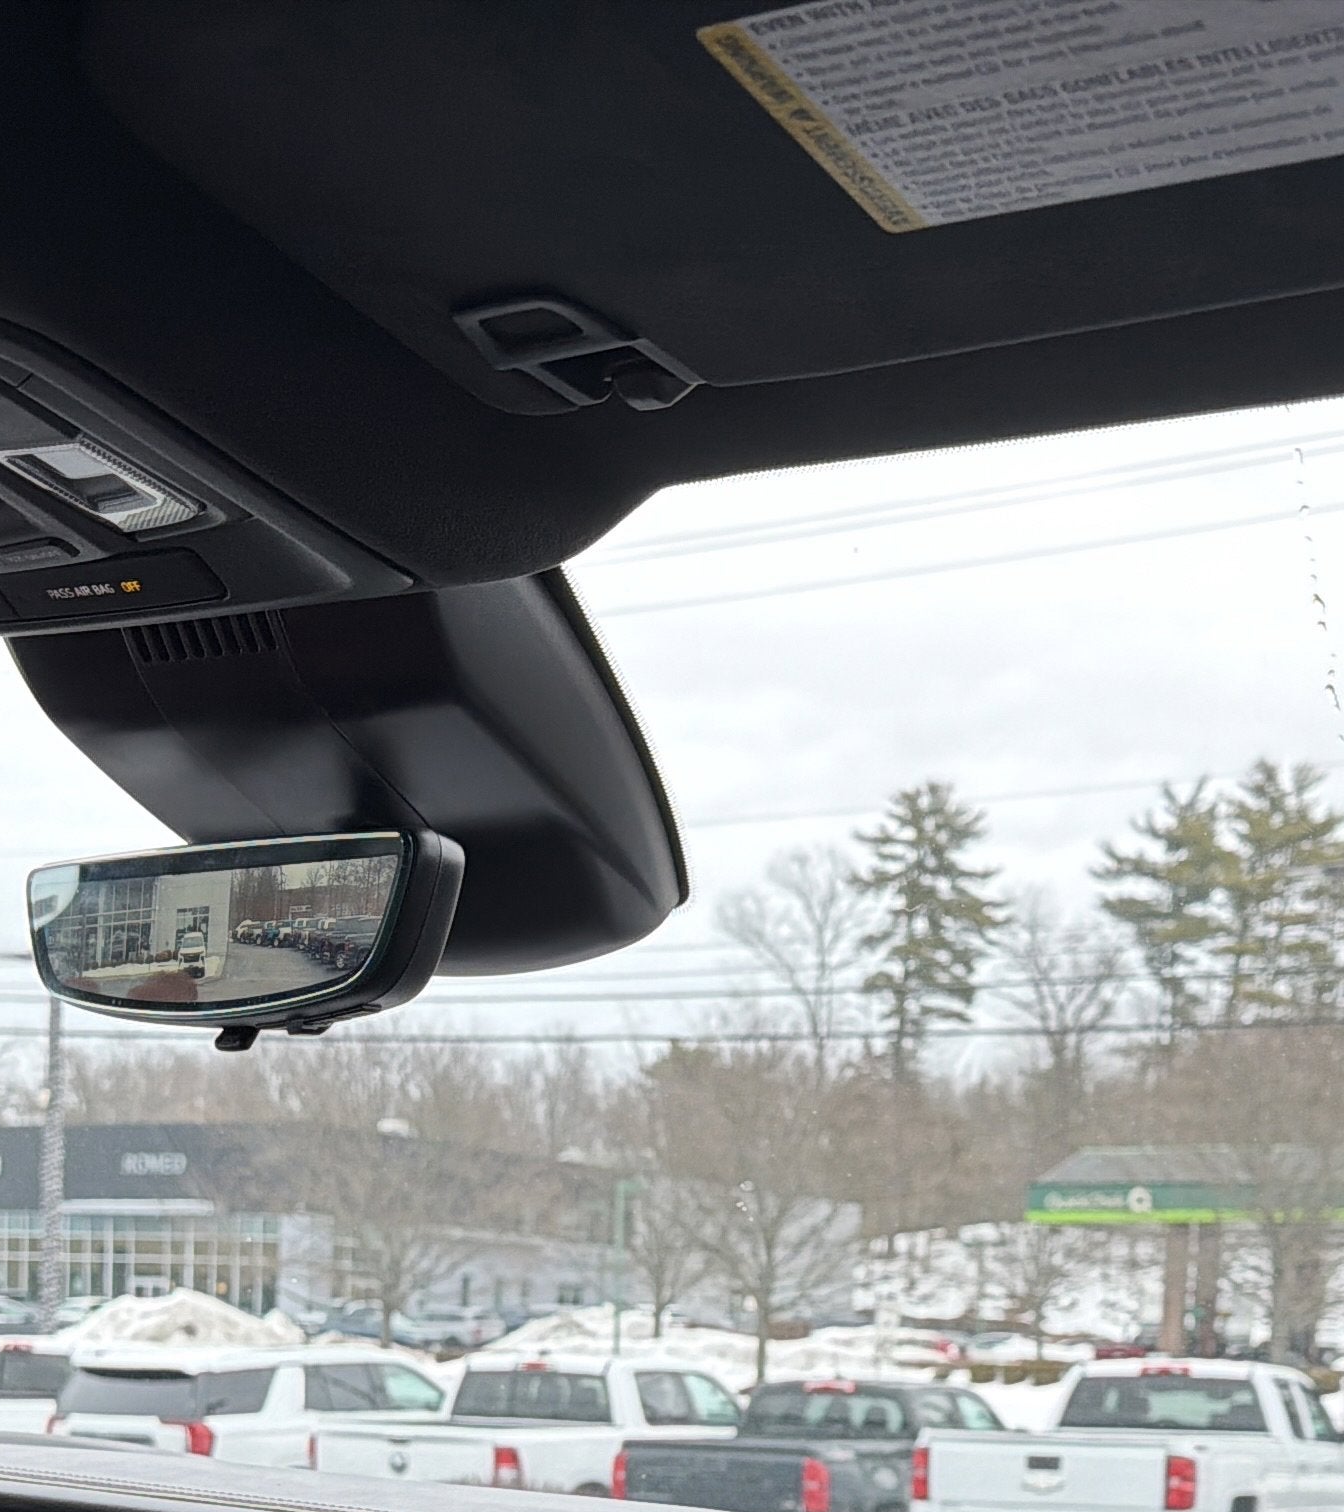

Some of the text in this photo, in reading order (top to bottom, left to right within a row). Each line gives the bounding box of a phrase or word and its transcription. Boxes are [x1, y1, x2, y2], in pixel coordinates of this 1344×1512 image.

[46, 580, 142, 601] PASS AIR BAG OFF
